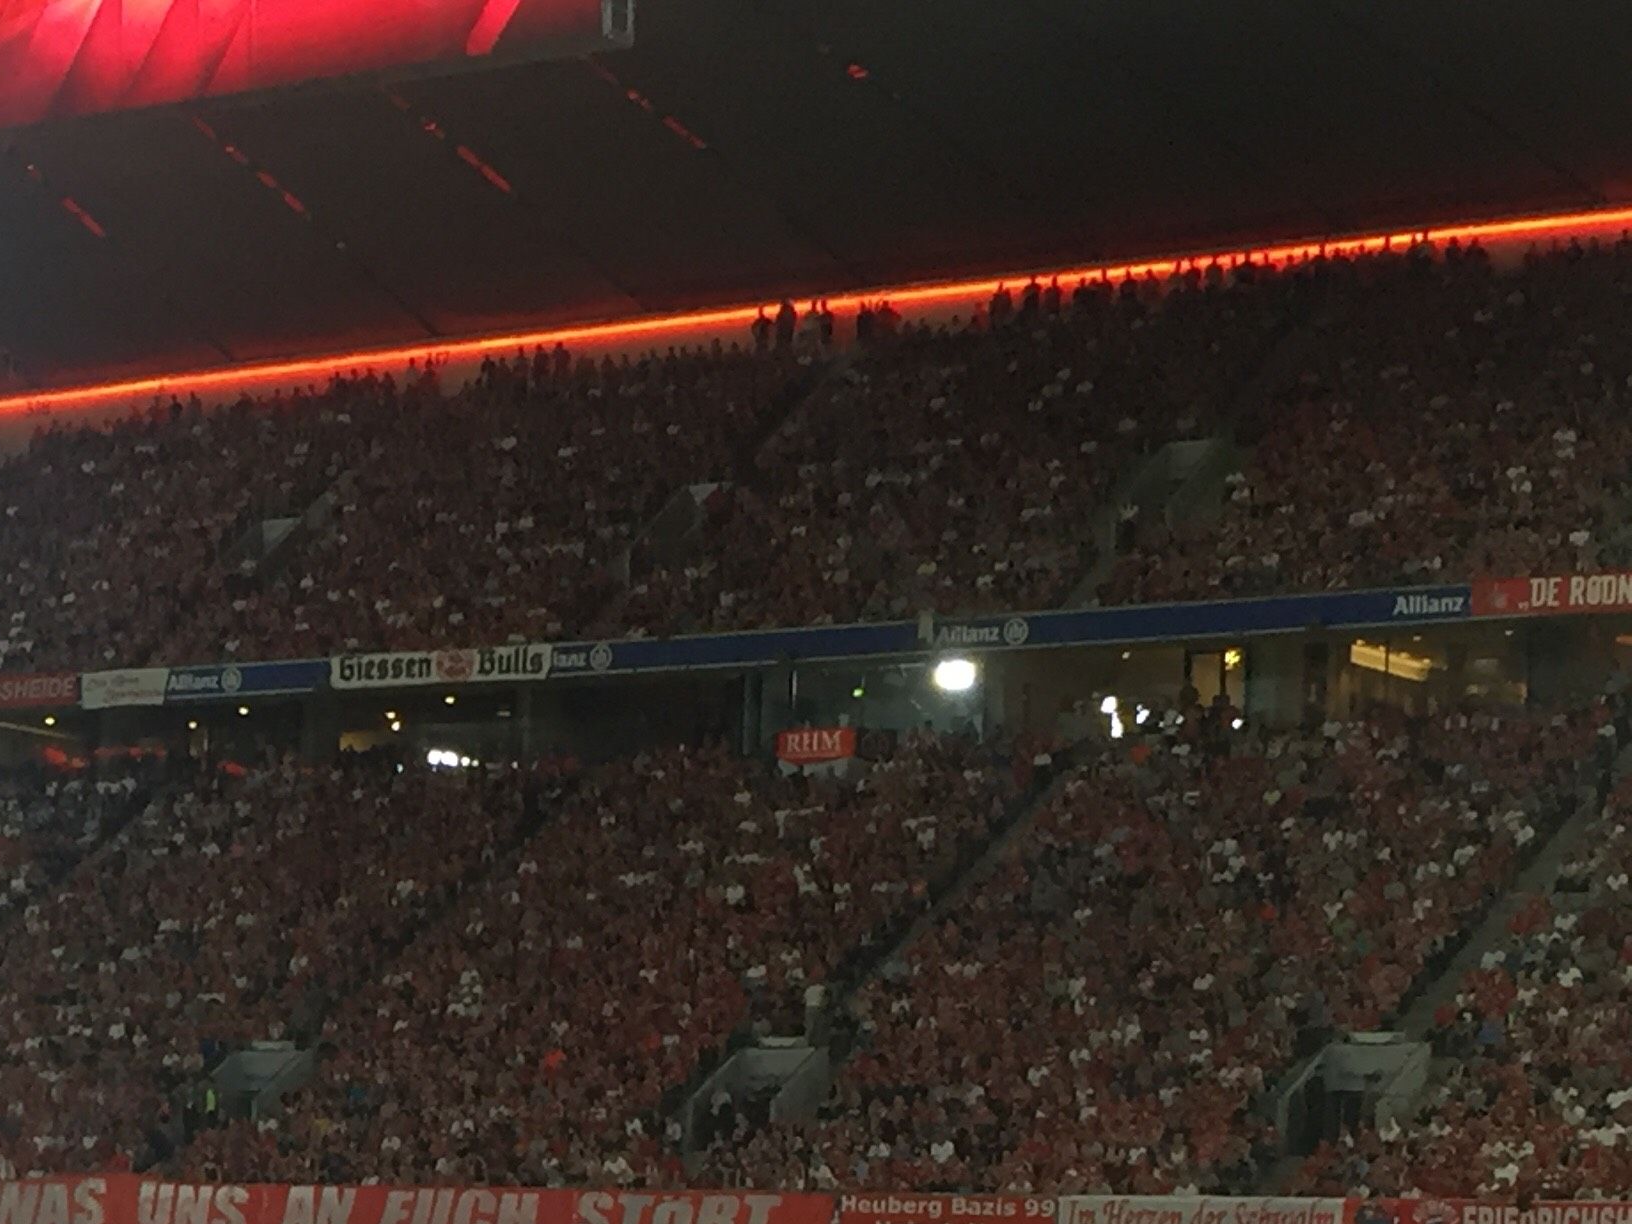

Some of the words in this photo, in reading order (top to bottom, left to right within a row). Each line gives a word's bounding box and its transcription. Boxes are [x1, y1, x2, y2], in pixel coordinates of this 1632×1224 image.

[1530, 577, 1563, 607] DE
[1392, 596, 1464, 615] Allianz
[935, 625, 999, 645] Allianz
[478, 648, 544, 676] Bulls
[169, 674, 219, 691] Allianz
[841, 1195, 943, 1217] Heuberg
[1024, 1198, 1056, 1218] 99
